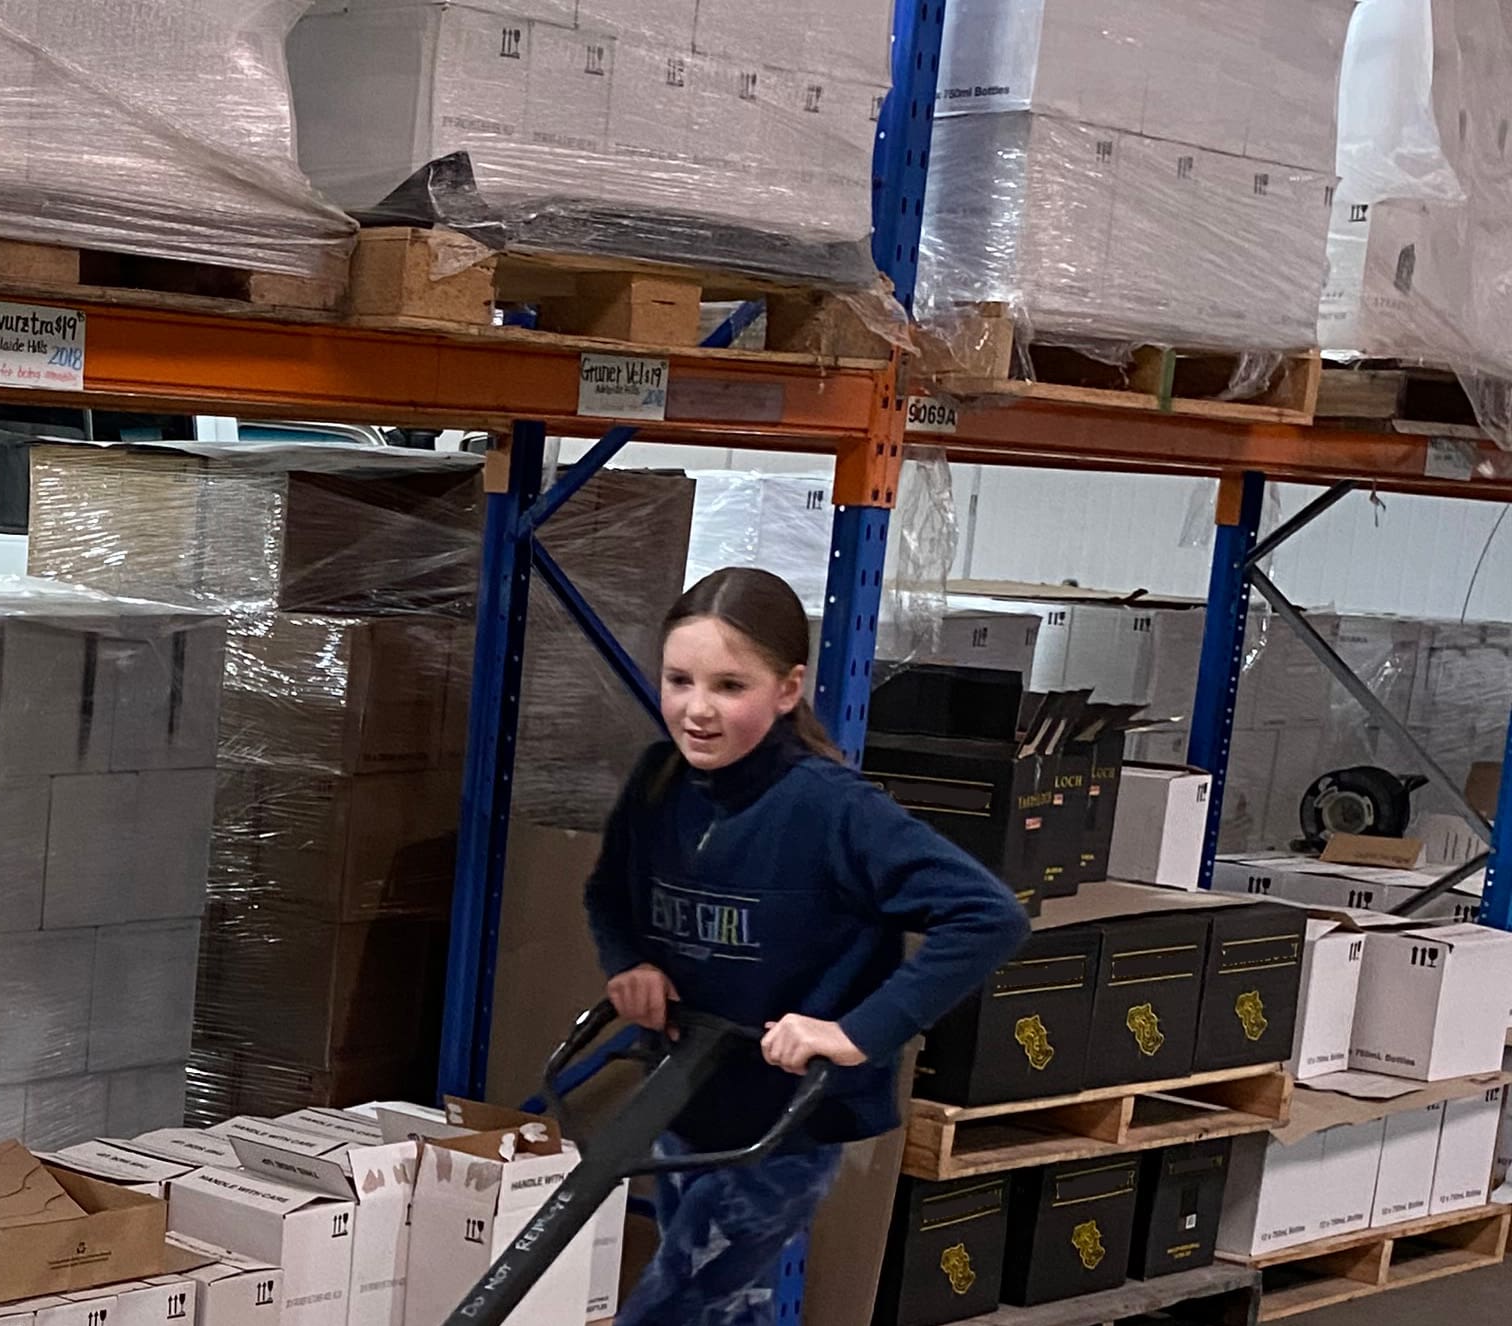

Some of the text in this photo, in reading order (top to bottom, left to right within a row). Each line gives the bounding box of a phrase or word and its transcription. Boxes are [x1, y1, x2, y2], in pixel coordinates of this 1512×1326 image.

[28, 340, 48, 354] Hills
[48, 346, 83, 371] 2018
[581, 357, 621, 384] Gruner
[908, 404, 956, 426] 9069A
[695, 902, 760, 948] GIRL
[232, 1123, 318, 1148] HANDLE WITH CARE
[299, 1115, 336, 1129] HANDLE
[340, 1125, 361, 1136] WITH
[200, 1173, 290, 1204] HANDLE WITH CARE
[511, 1175, 544, 1191] HANDLE
